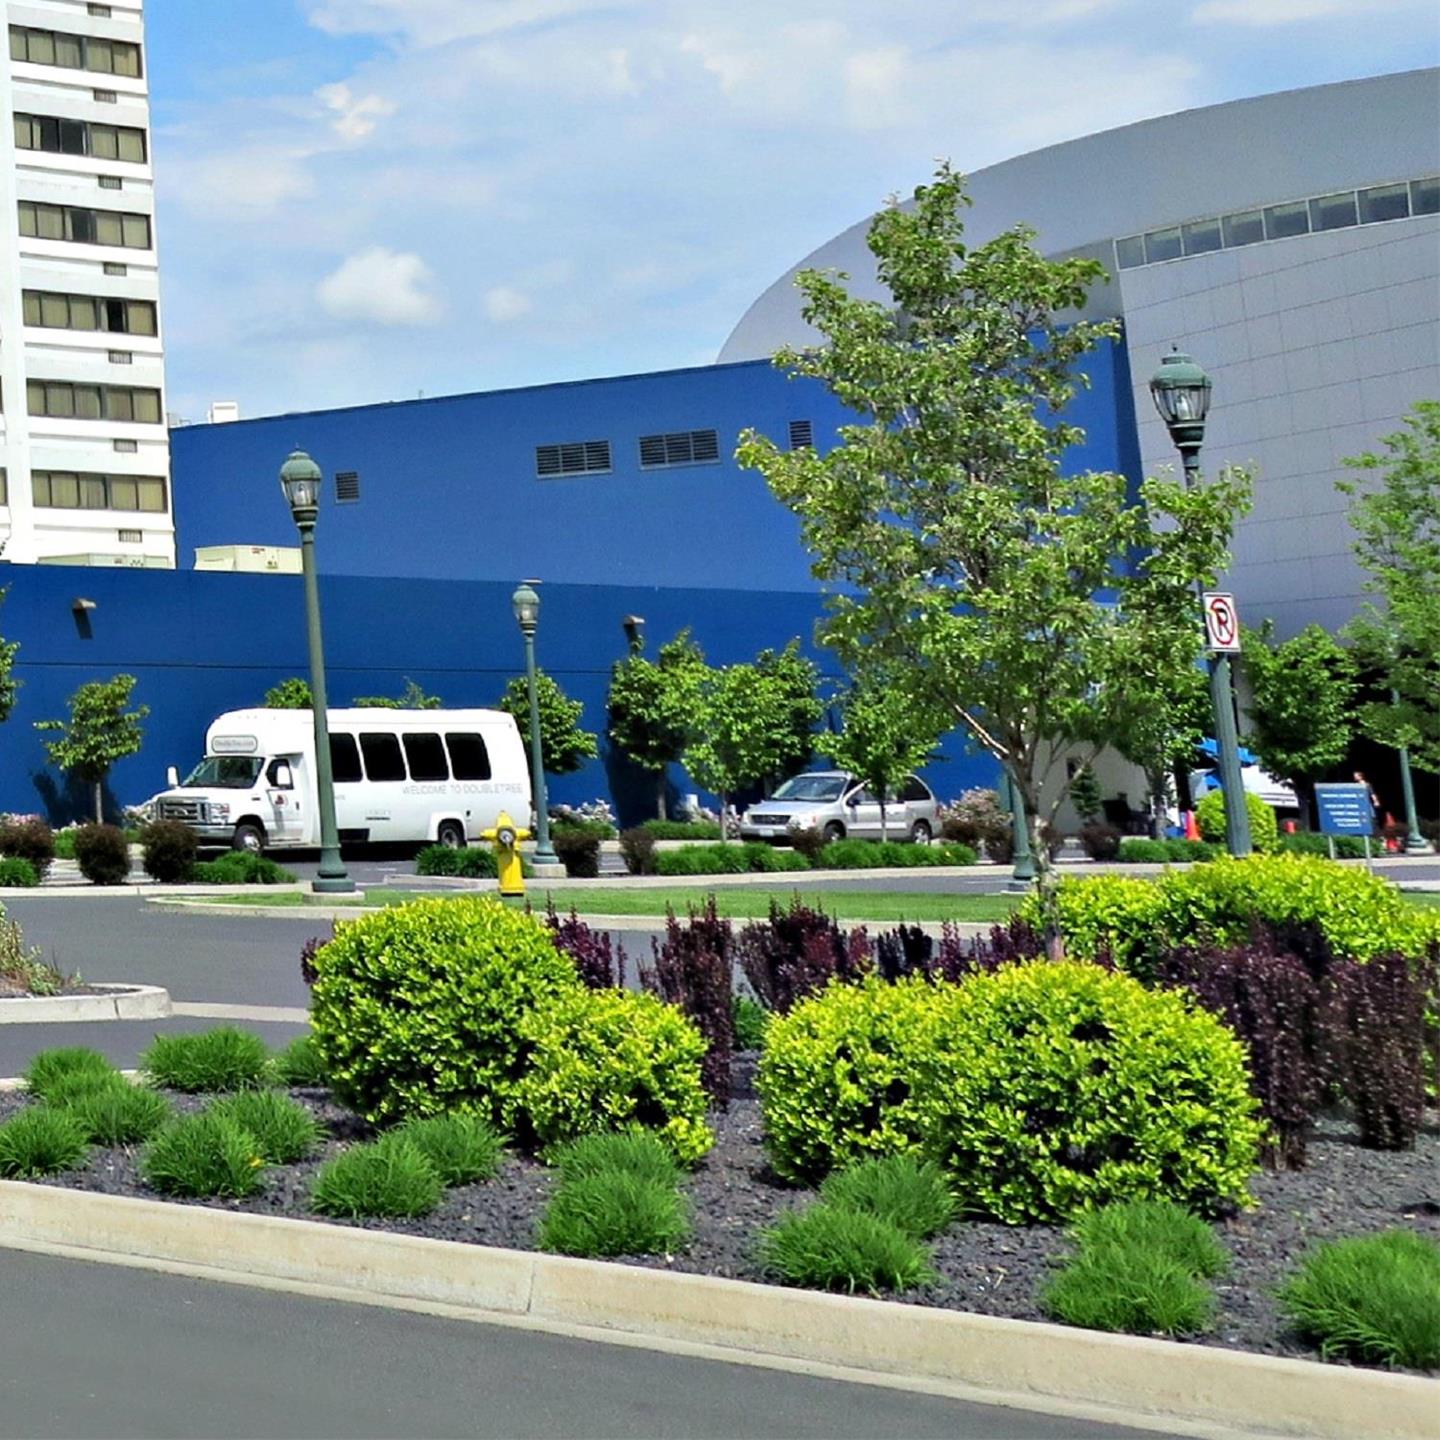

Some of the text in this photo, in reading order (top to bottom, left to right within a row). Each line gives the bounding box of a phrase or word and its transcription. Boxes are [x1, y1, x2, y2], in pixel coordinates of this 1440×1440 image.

[403, 783, 522, 795] WELCOME TO DOUBLETREE
